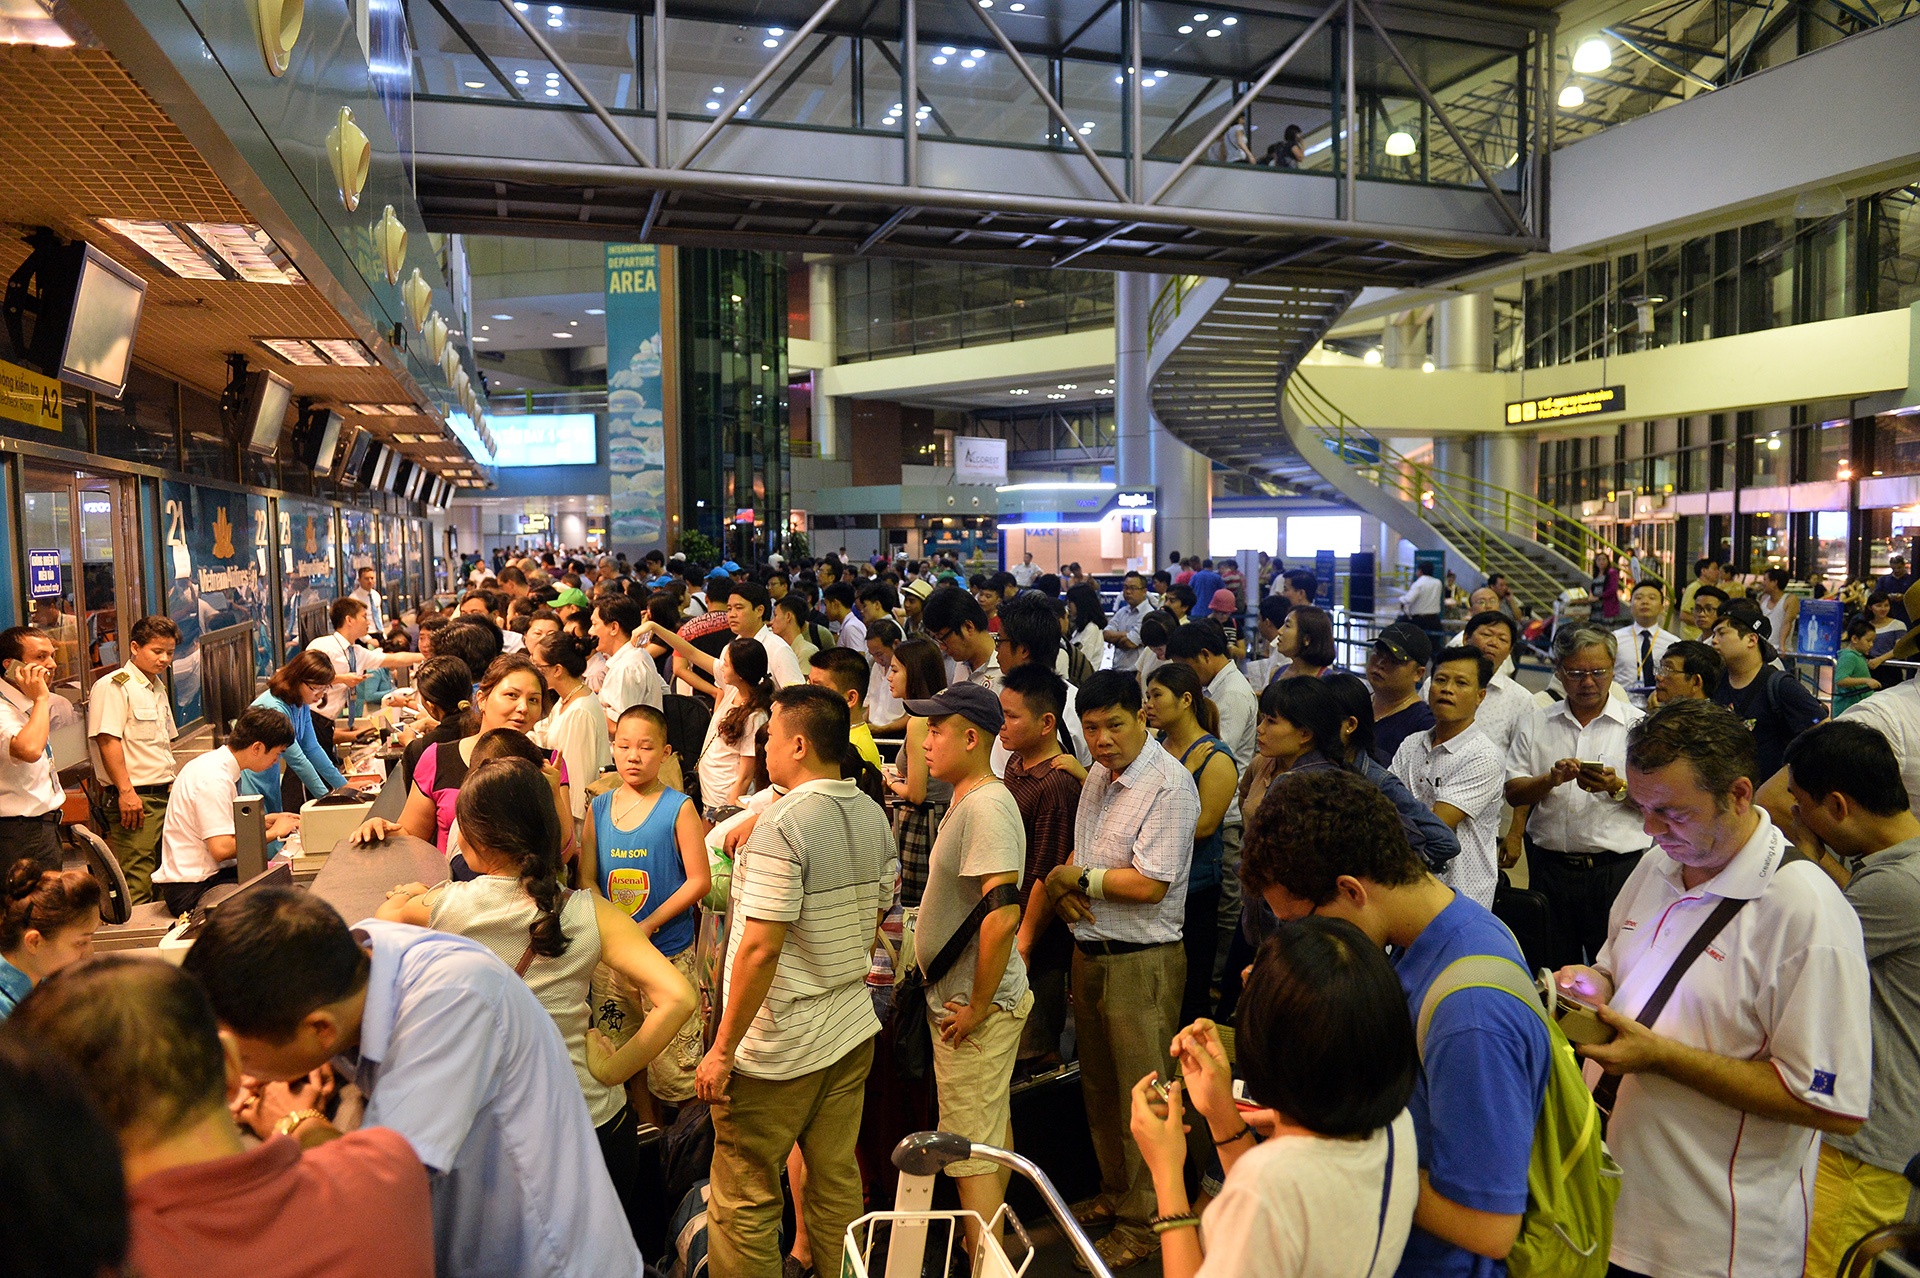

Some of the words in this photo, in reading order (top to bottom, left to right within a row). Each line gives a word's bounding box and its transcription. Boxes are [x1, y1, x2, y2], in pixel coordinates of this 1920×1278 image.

[608, 255, 655, 269] DEPARTURE
[609, 269, 657, 294] AREA
[31, 382, 39, 396] tra
[20, 398, 35, 413] Room
[41, 385, 59, 420] A2
[166, 499, 186, 547] 21
[255, 509, 268, 546] 22
[279, 511, 291, 545] 23
[1026, 528, 1054, 537] VATC
[612, 876, 643, 885] Arsenal
